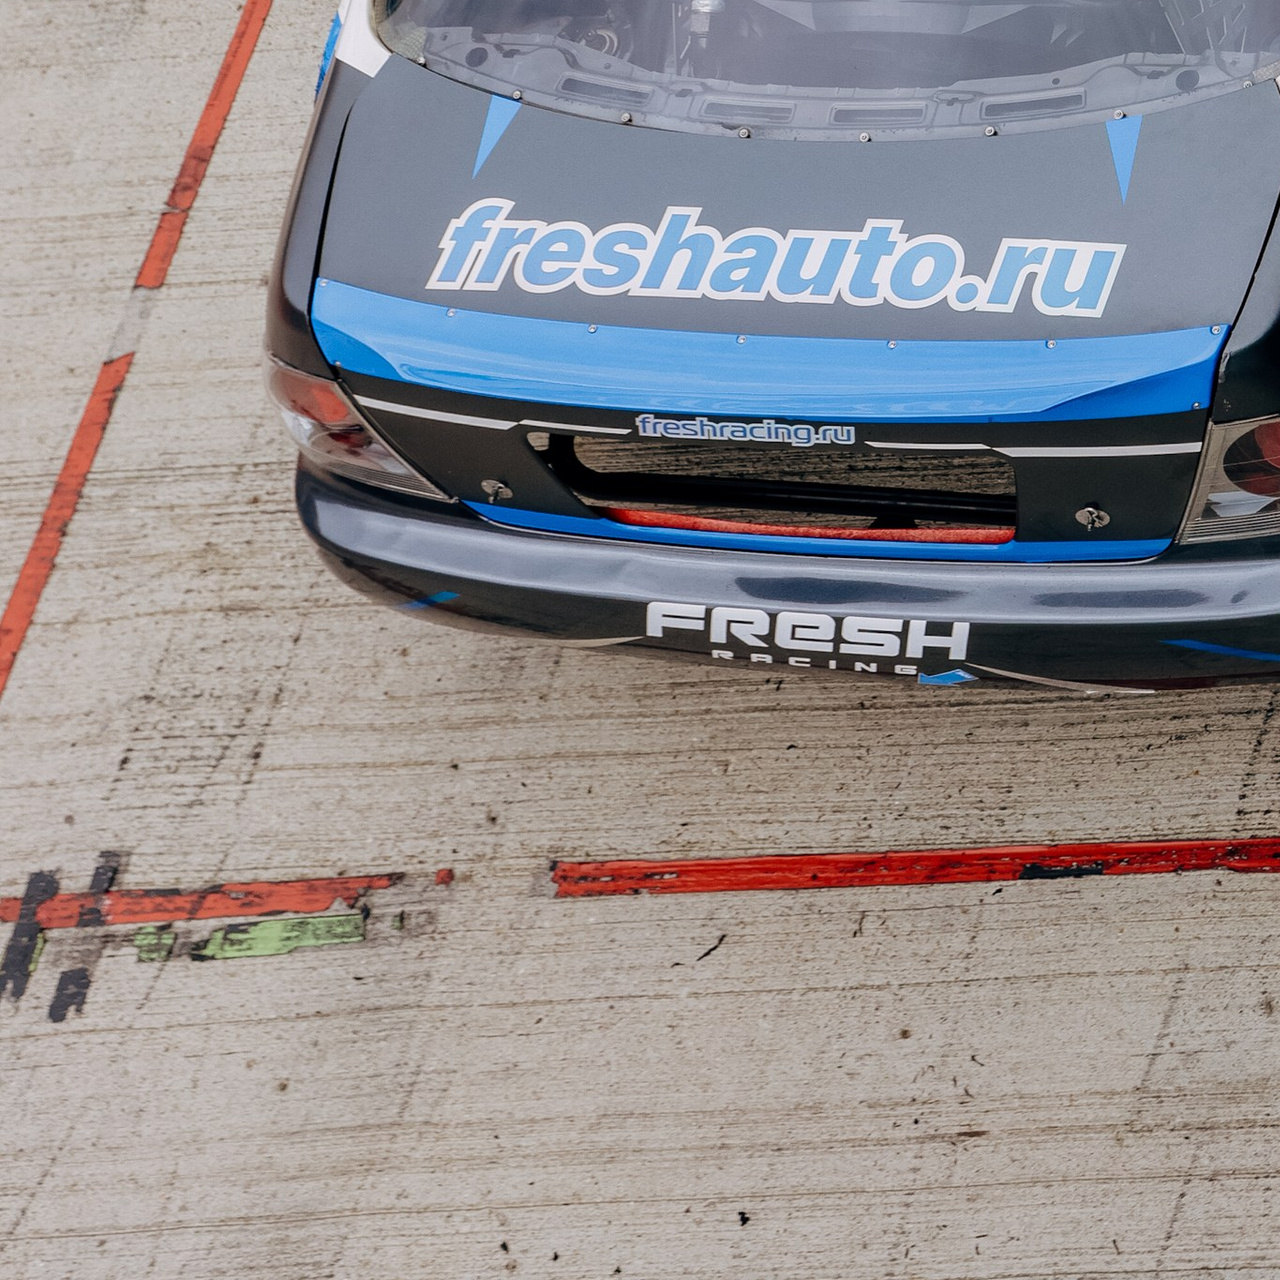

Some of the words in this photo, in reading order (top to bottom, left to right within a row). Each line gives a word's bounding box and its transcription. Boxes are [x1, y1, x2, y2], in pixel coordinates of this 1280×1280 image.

[425, 197, 1126, 318] freshauto.ru
[637, 414, 856, 447] freshracing.ru
[646, 602, 970, 660] FRESH
[712, 649, 919, 677] RACING
